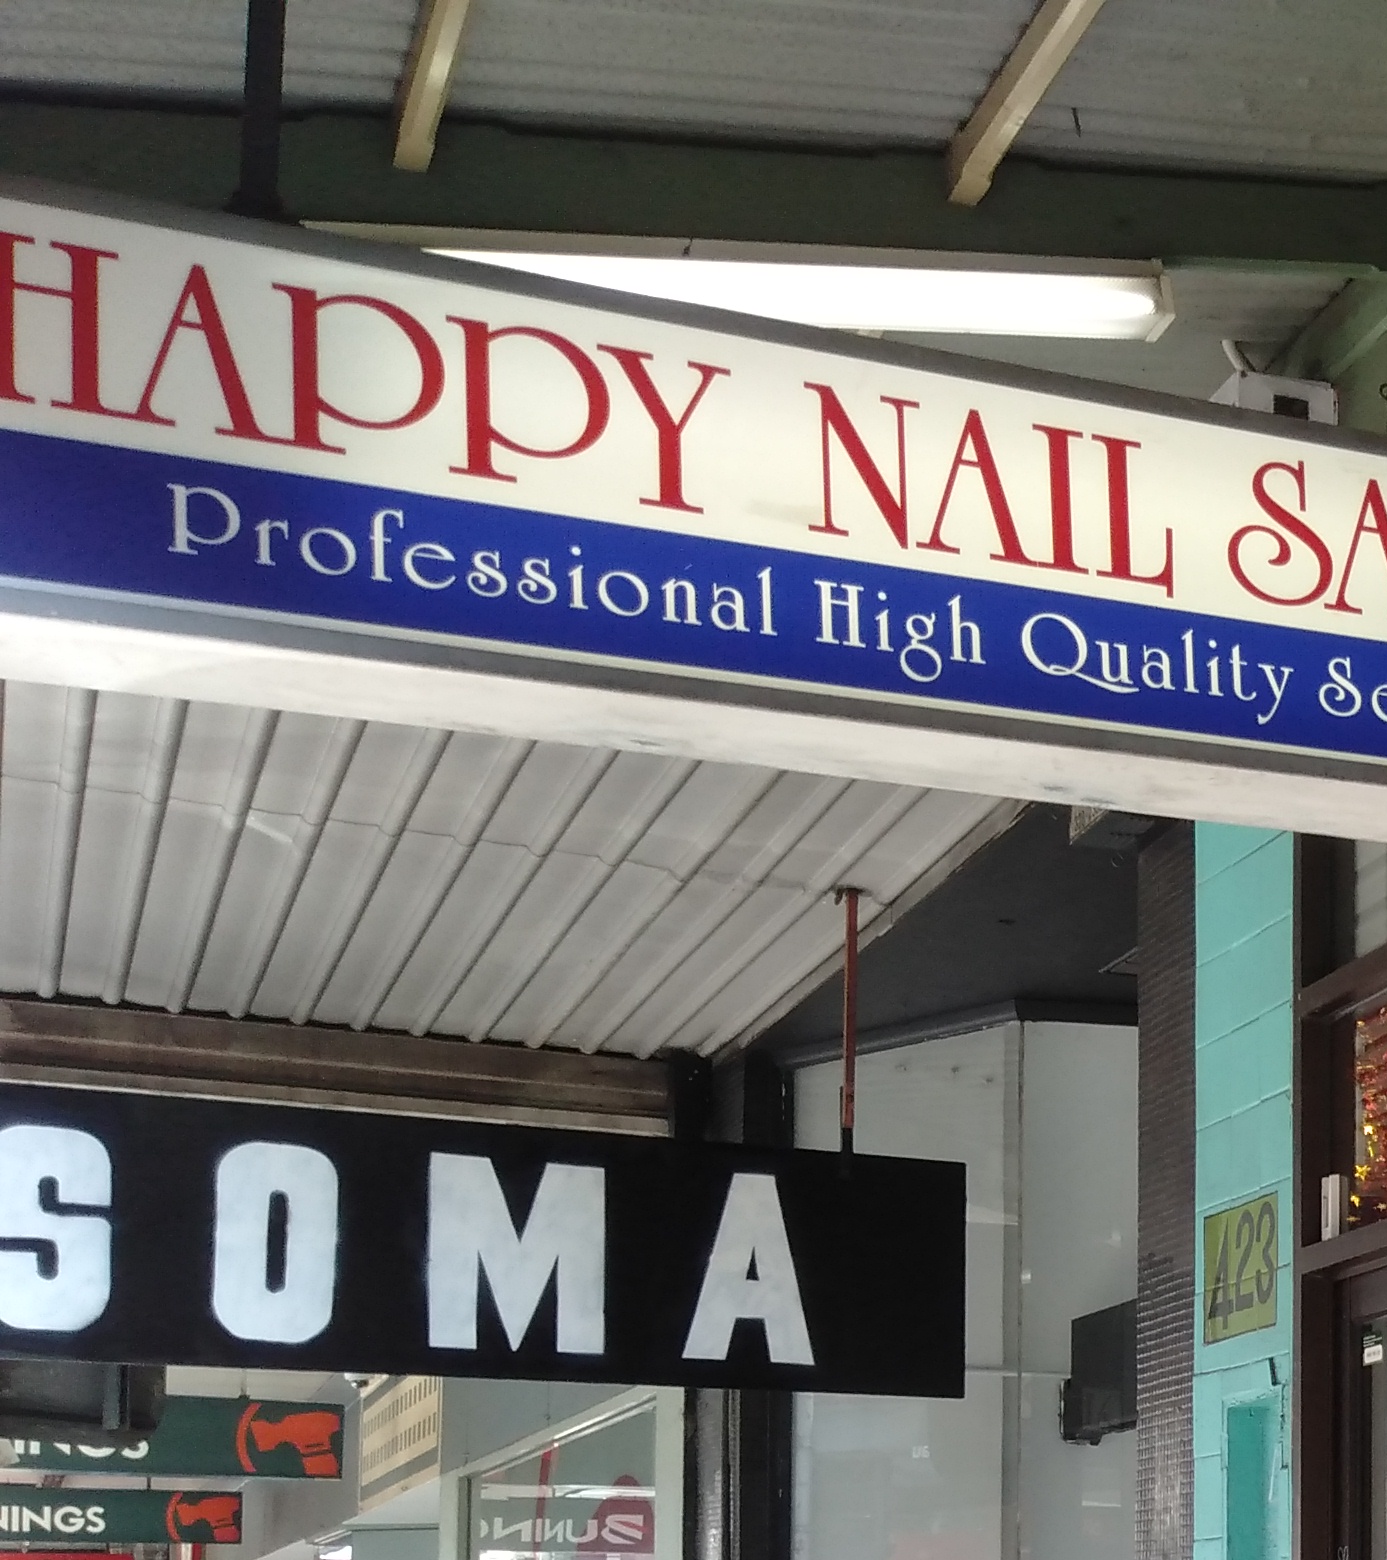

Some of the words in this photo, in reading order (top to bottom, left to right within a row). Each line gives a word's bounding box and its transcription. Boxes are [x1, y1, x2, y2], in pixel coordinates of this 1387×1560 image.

[0, 231, 730, 515] HAPPY
[803, 382, 1174, 599] NAIL
[167, 482, 778, 637] Professional
[814, 578, 987, 685] High
[1021, 612, 1295, 726] Quality
[0, 1124, 815, 1367] SOMA
[1209, 1201, 1277, 1331] 423
